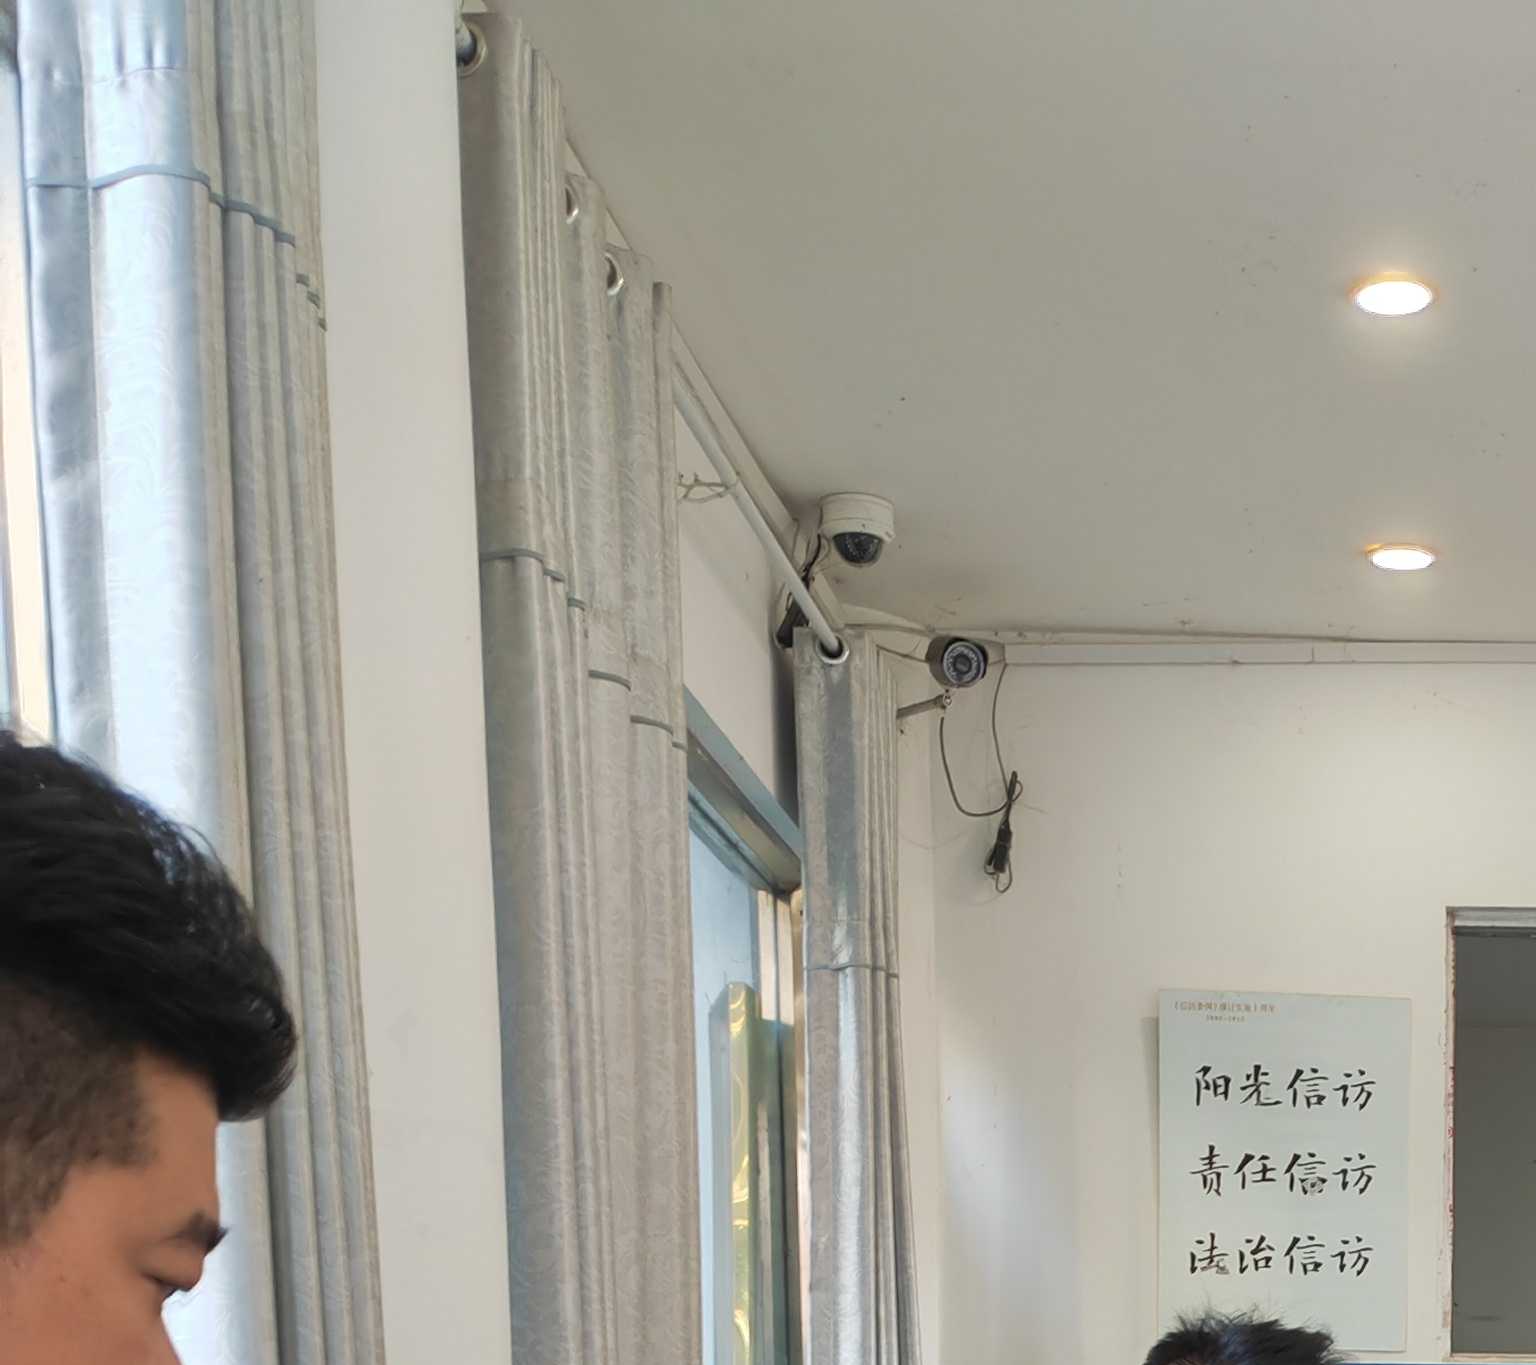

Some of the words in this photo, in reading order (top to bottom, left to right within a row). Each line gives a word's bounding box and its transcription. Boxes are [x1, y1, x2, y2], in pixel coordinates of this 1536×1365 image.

[1194, 1064, 1377, 1111] 阳光信访
[1190, 1144, 1377, 1196] 责任信访
[1190, 1232, 1374, 1276] 法治信访
